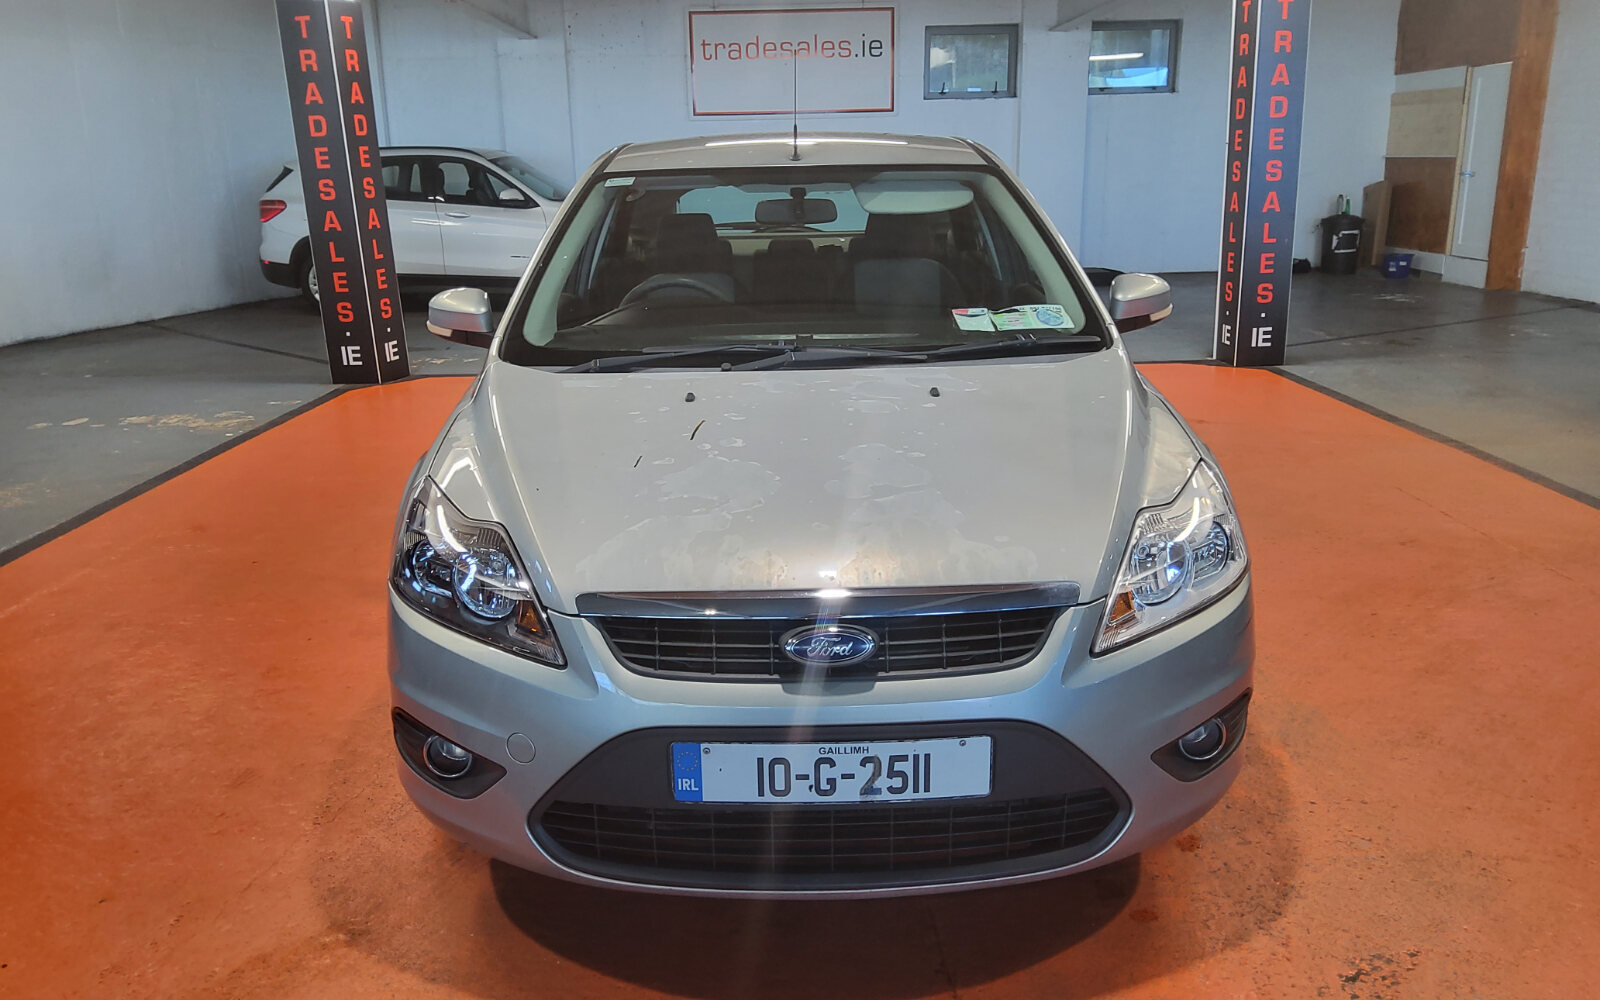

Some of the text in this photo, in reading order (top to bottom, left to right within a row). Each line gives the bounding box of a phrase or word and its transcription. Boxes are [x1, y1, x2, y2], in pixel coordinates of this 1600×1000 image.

[700, 33, 883, 61] tradesales.ie
[294, 15, 363, 366] TRADESALES.IE
[340, 15, 399, 362] TRADESALES.IE
[1221, 0, 1251, 345] TRADESALES.IE
[807, 637, 853, 657] Ford
[818, 746, 870, 755] GAILLIMH
[677, 778, 699, 791] IRL
[757, 753, 931, 797] 10-G-2511
